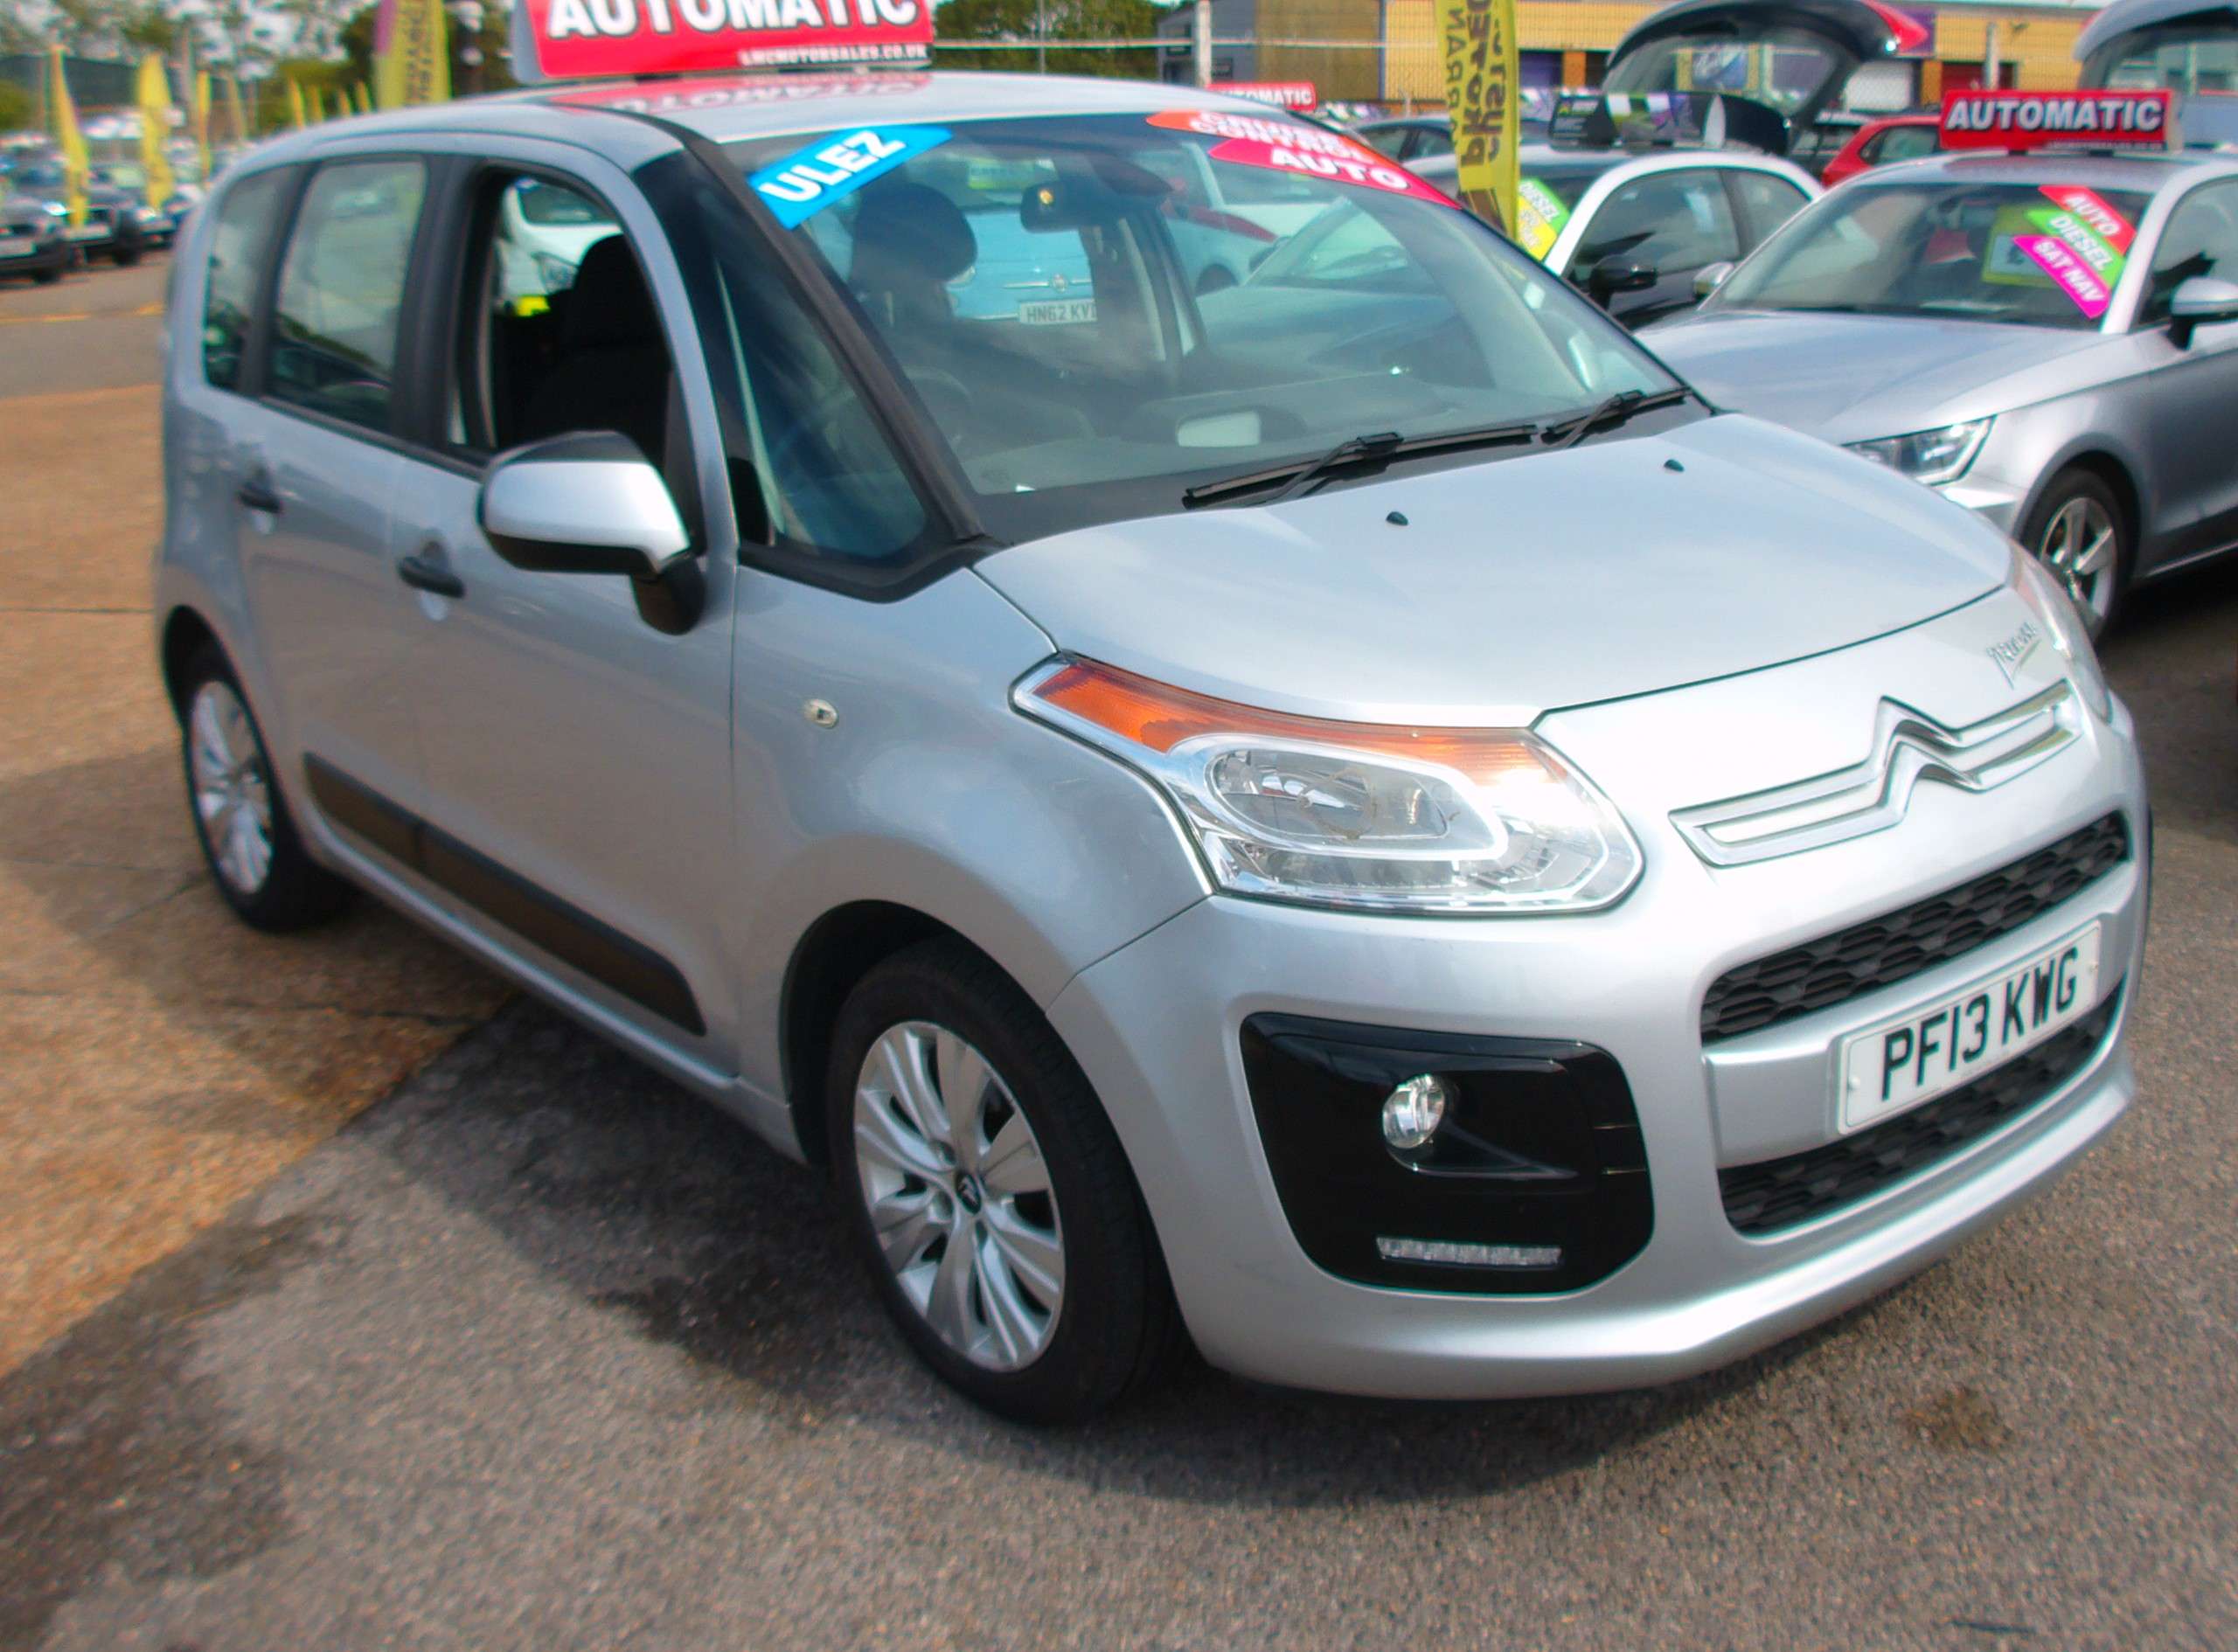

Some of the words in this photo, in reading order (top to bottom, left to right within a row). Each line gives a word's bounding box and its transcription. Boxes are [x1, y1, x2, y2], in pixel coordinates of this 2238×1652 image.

[547, 0, 918, 38] AUTOMATIC
[1945, 98, 2164, 131] AUTOMATIC
[758, 129, 907, 202] ULEZ
[1271, 147, 1410, 190] AUTO
[2064, 193, 2121, 236] AUTO
[2049, 214, 2113, 270] DIESEL
[2033, 240, 2074, 268] SAT
[2063, 269, 2105, 302] NAV
[1881, 992, 1990, 1101] PF13
[2001, 946, 2079, 1045] KWG
